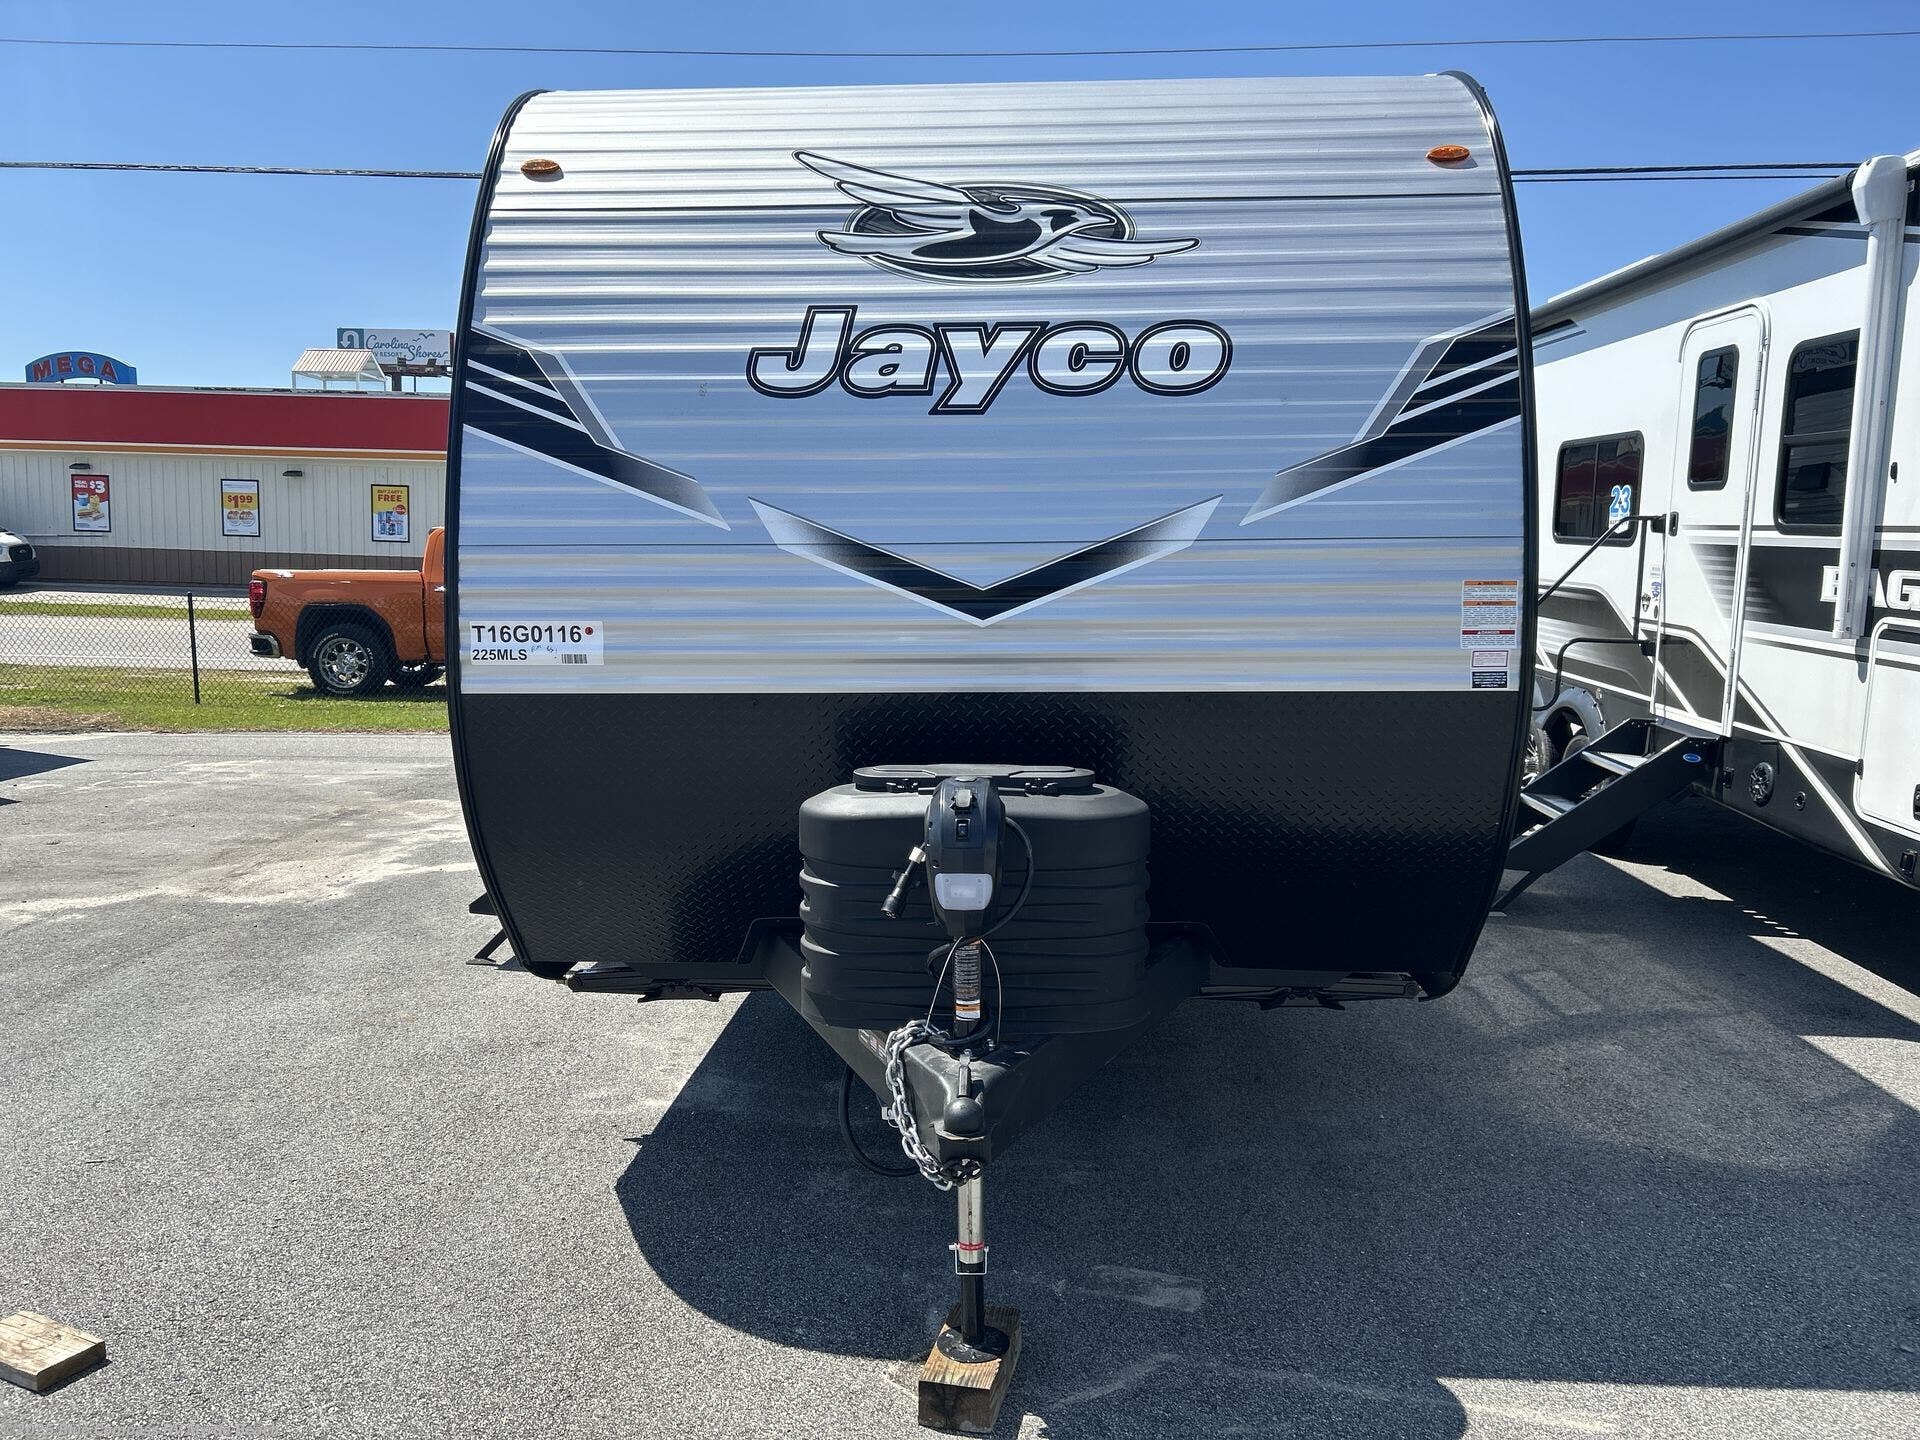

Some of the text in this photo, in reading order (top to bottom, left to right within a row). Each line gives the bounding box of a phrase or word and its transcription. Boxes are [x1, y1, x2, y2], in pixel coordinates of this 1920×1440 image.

[366, 334, 409, 350] Carolina
[405, 345, 448, 361] Shores
[745, 304, 1233, 415] Jayco
[32, 354, 118, 382] MEGA
[88, 480, 105, 494] $3
[377, 494, 402, 502] FREE
[472, 625, 582, 643] T16G0116
[472, 649, 527, 660] 225MLS
